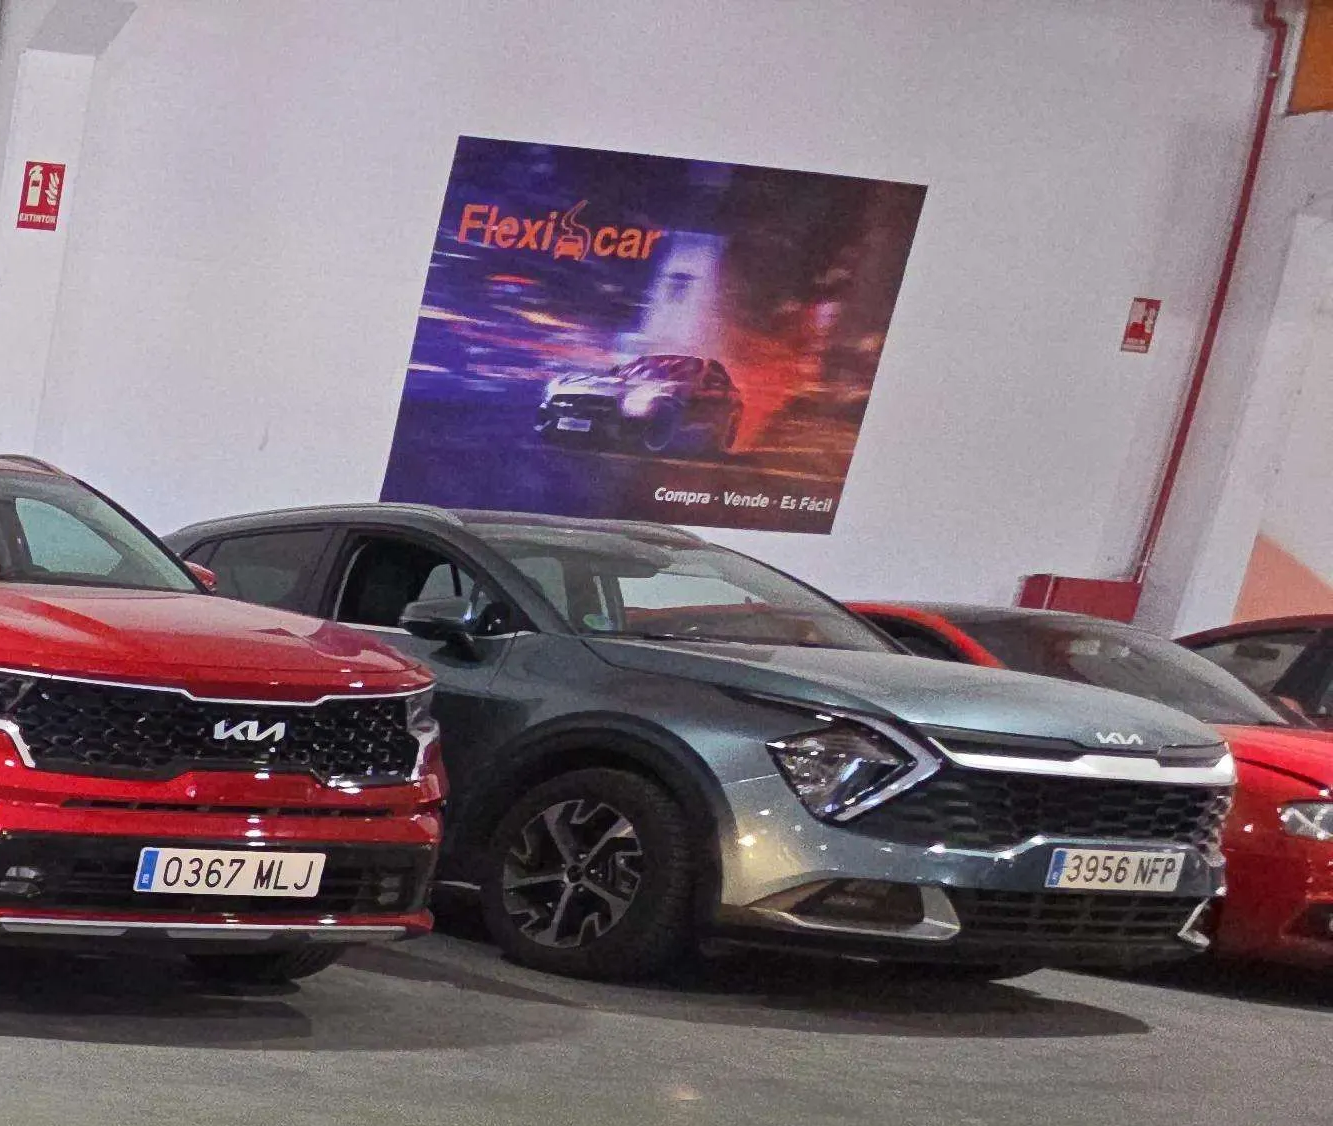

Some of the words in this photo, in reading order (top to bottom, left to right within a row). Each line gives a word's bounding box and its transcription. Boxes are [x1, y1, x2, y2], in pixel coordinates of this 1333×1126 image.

[654, 487, 710, 506] Compra
[723, 491, 770, 508] Vende
[780, 495, 796, 510] Es
[799, 495, 833, 513] Fácil
[162, 856, 246, 889] 0367
[253, 859, 314, 891] MLJ
[1066, 854, 1130, 883] 3956
[1133, 857, 1176, 885] NFP
